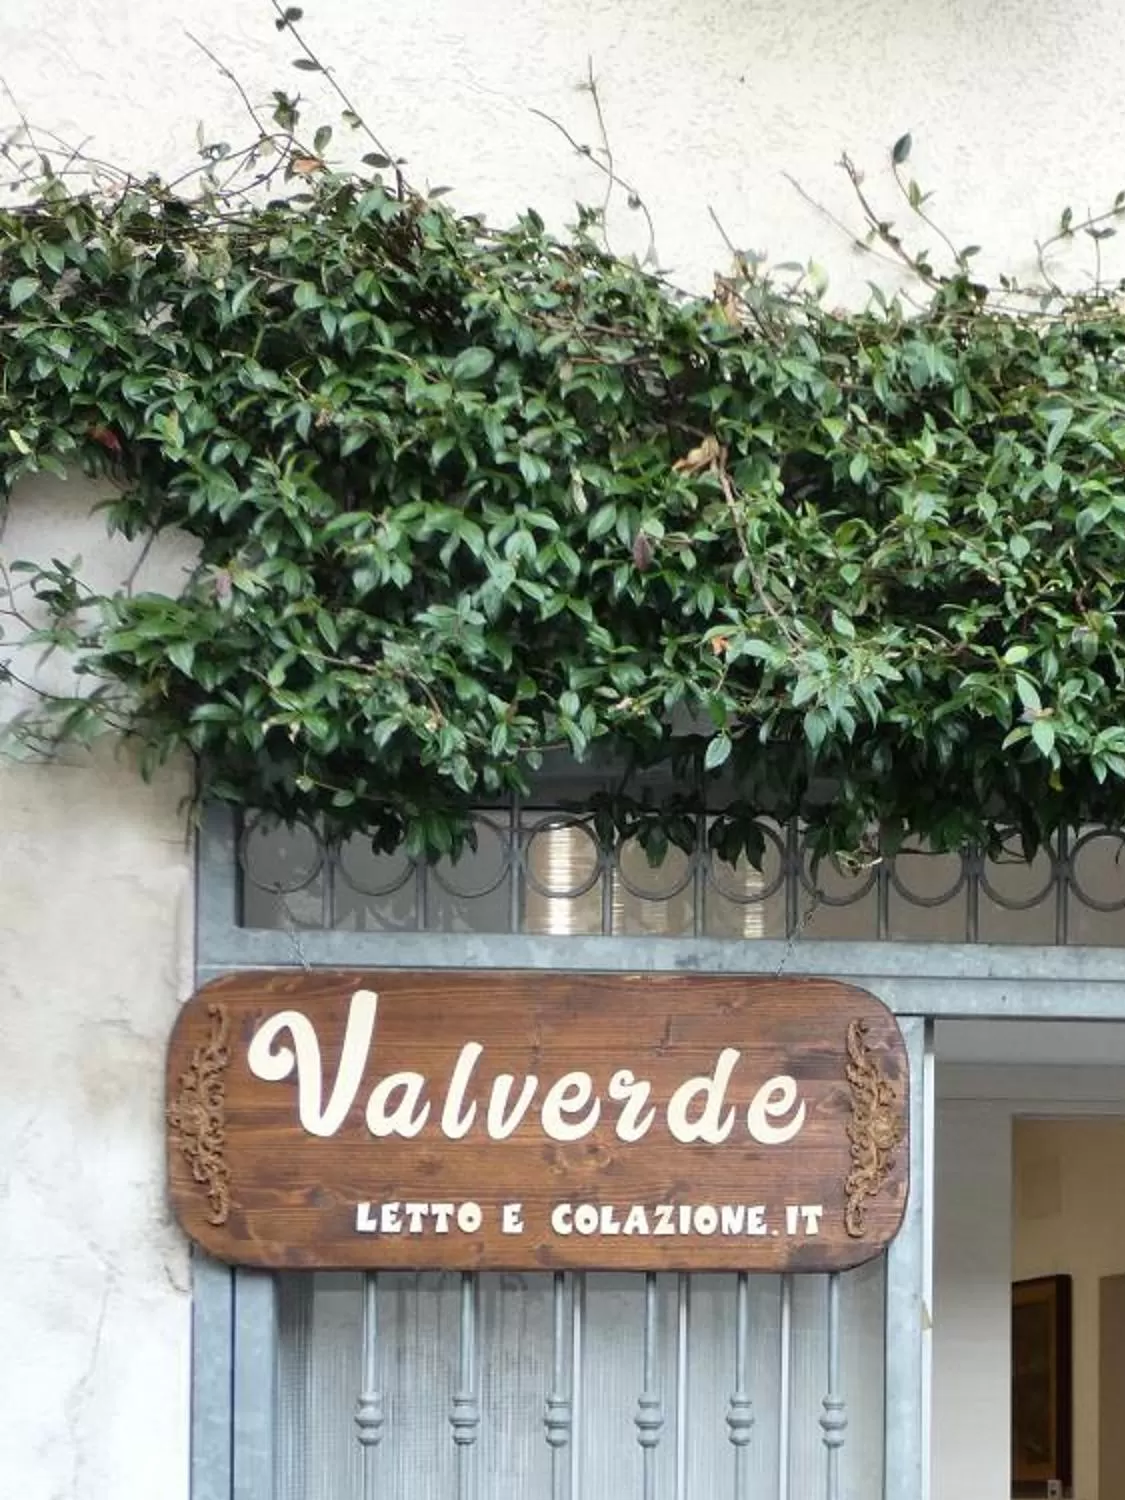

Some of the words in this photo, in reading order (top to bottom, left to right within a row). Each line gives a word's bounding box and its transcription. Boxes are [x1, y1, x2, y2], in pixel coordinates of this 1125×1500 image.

[247, 989, 806, 1145] Valverde
[356, 1201, 483, 1234] LETTO
[502, 1203, 525, 1234] E
[550, 1203, 825, 1236] COLAZIONE.IT
